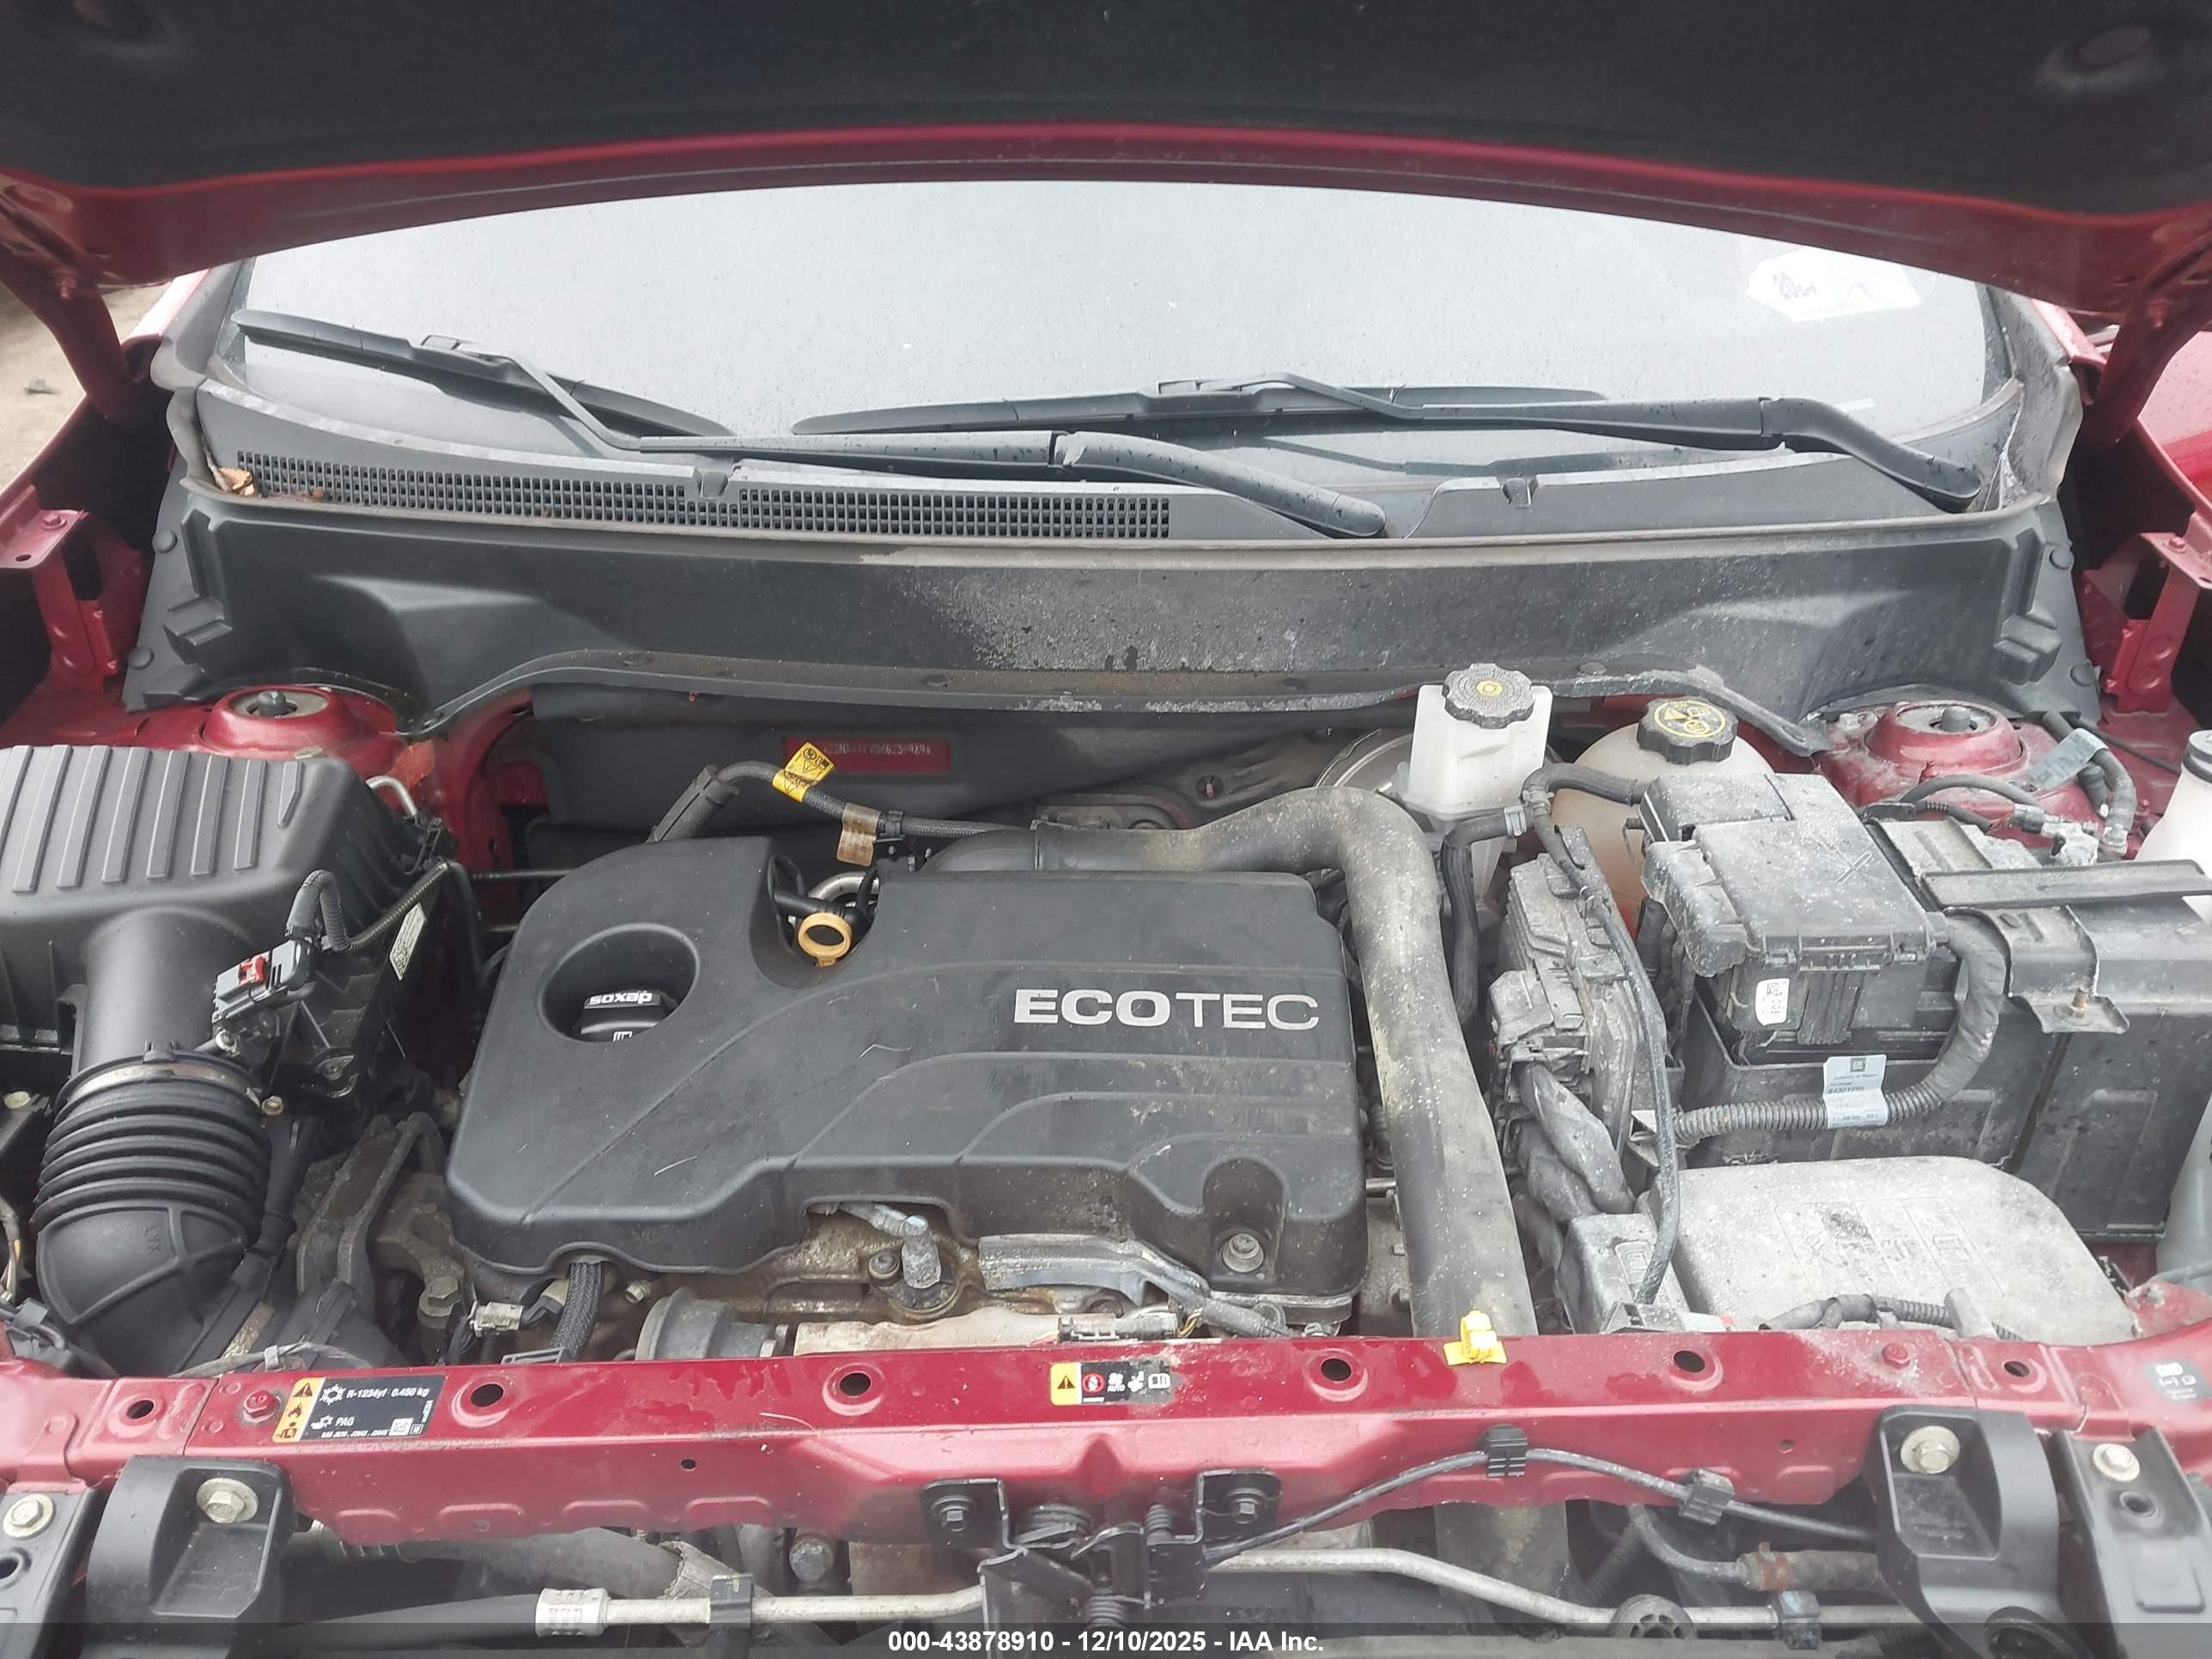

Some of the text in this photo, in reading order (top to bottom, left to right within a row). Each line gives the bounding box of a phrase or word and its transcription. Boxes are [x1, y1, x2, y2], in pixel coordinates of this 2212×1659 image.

[589, 992, 653, 1006] dexos
[1014, 989, 1319, 1030] ECOTEC
[416, 1388, 429, 1397] kg
[335, 1417, 355, 1426] PAG
